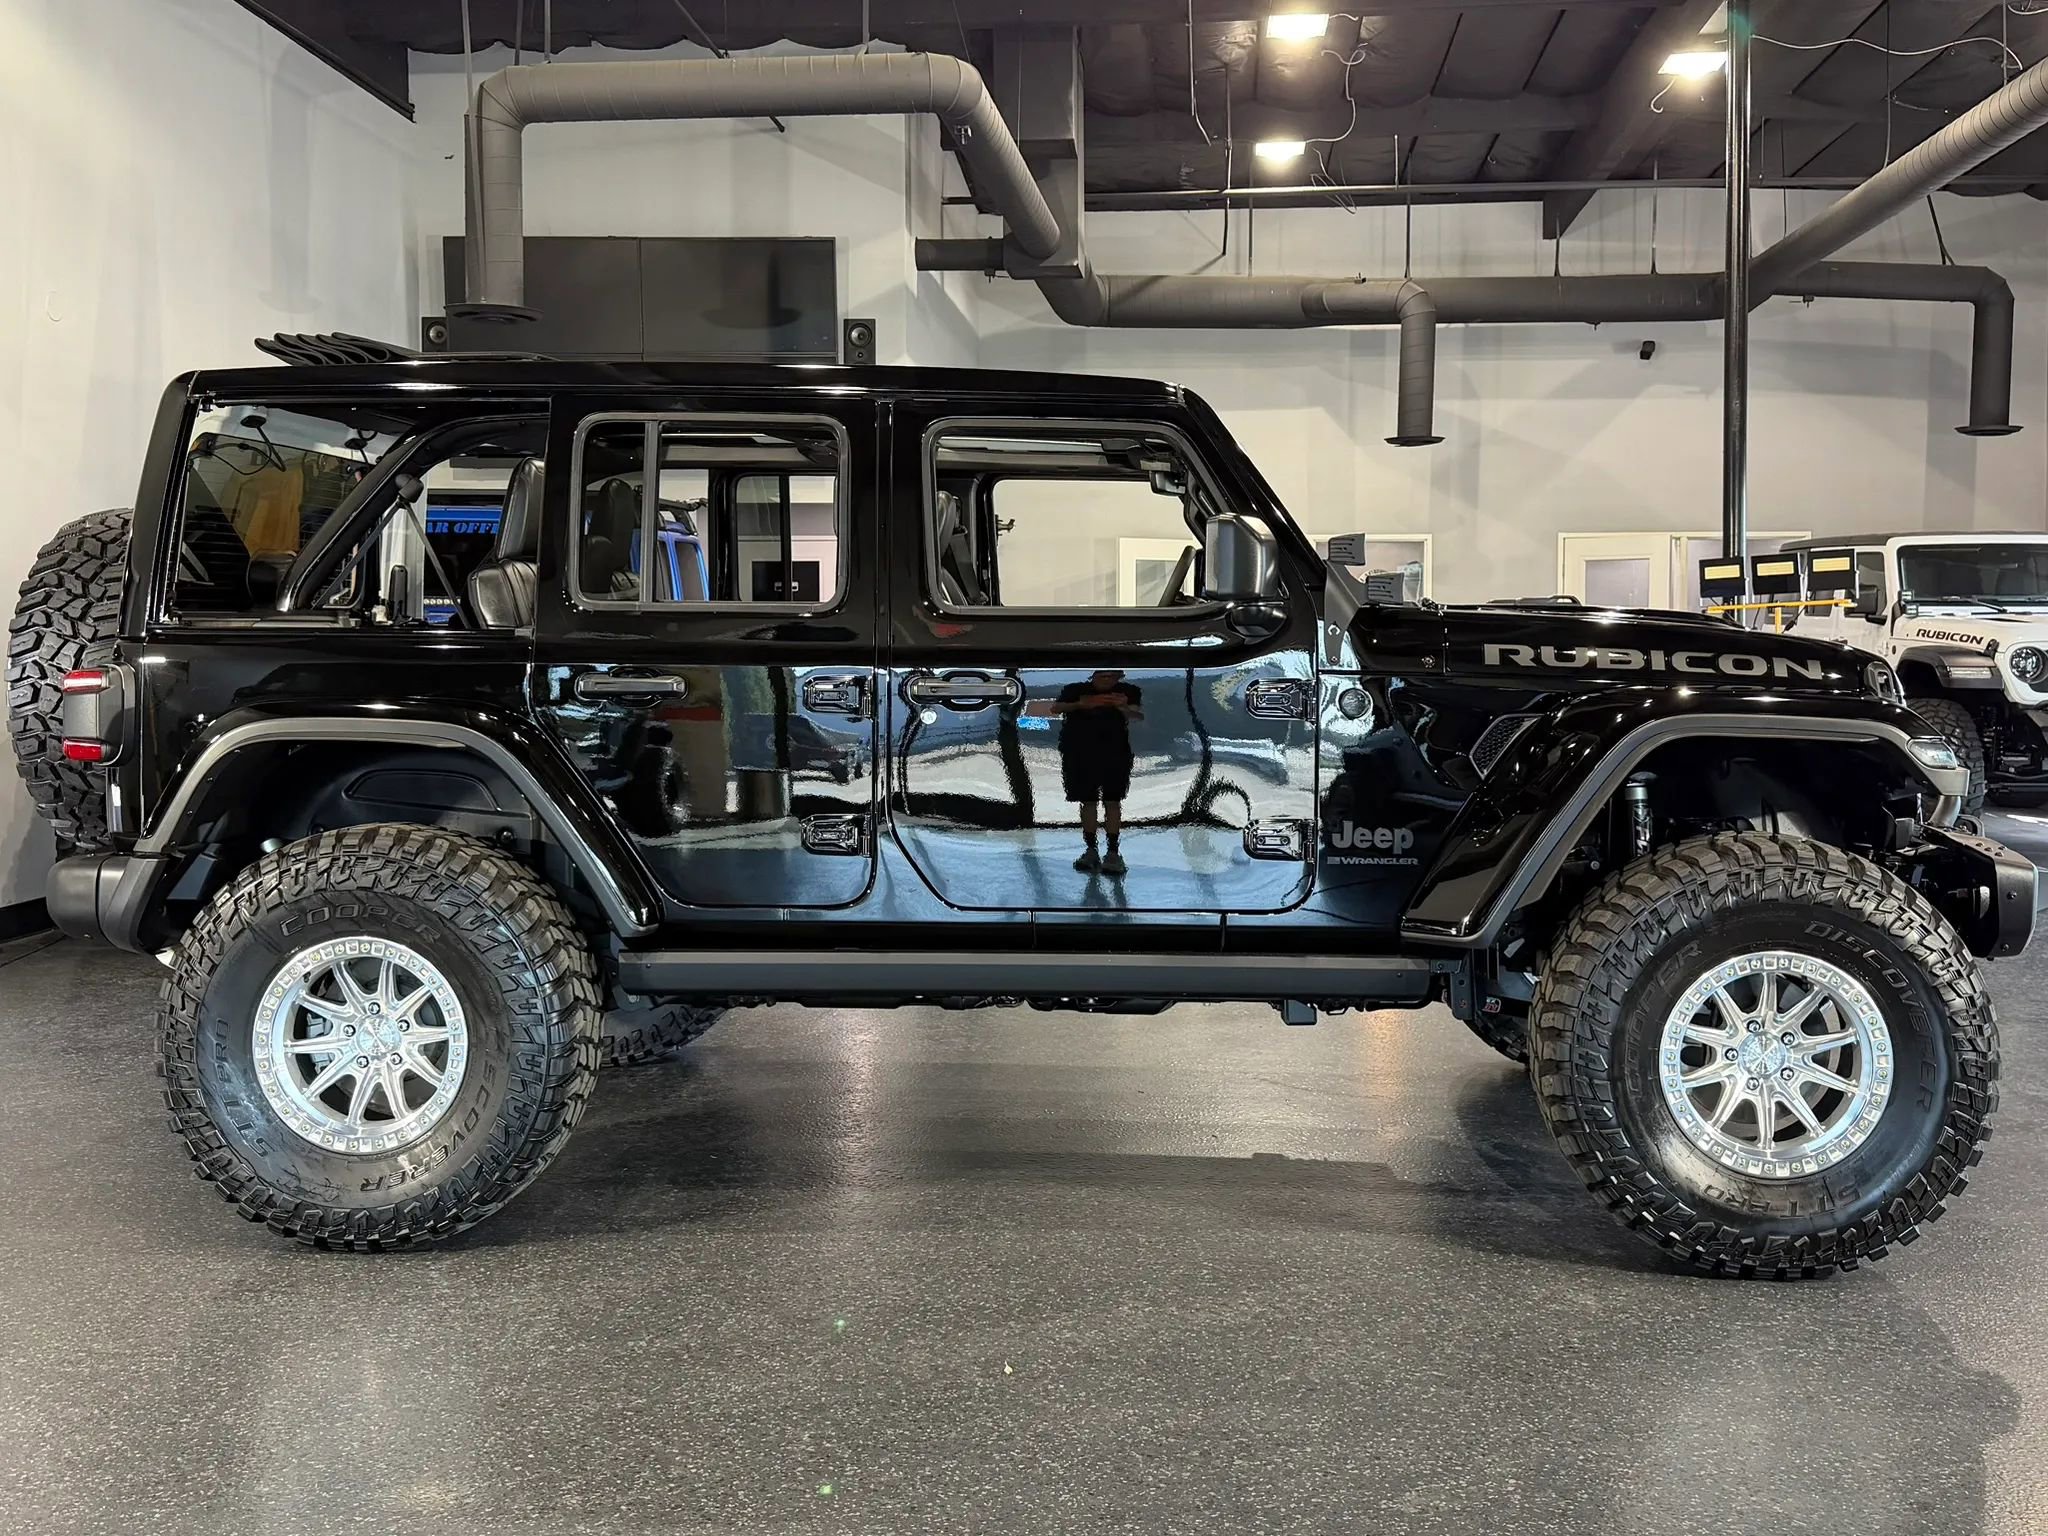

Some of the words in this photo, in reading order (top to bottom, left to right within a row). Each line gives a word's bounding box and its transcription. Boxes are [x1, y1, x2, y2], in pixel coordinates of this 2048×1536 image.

[1916, 628, 1984, 645] RUBICON
[1484, 643, 1823, 680] RUBICON
[1331, 821, 1414, 854] Jeep
[1341, 856, 1418, 865] WRANGLER
[279, 904, 441, 944] COOPER
[1803, 920, 1937, 1112] DISCOVERER
